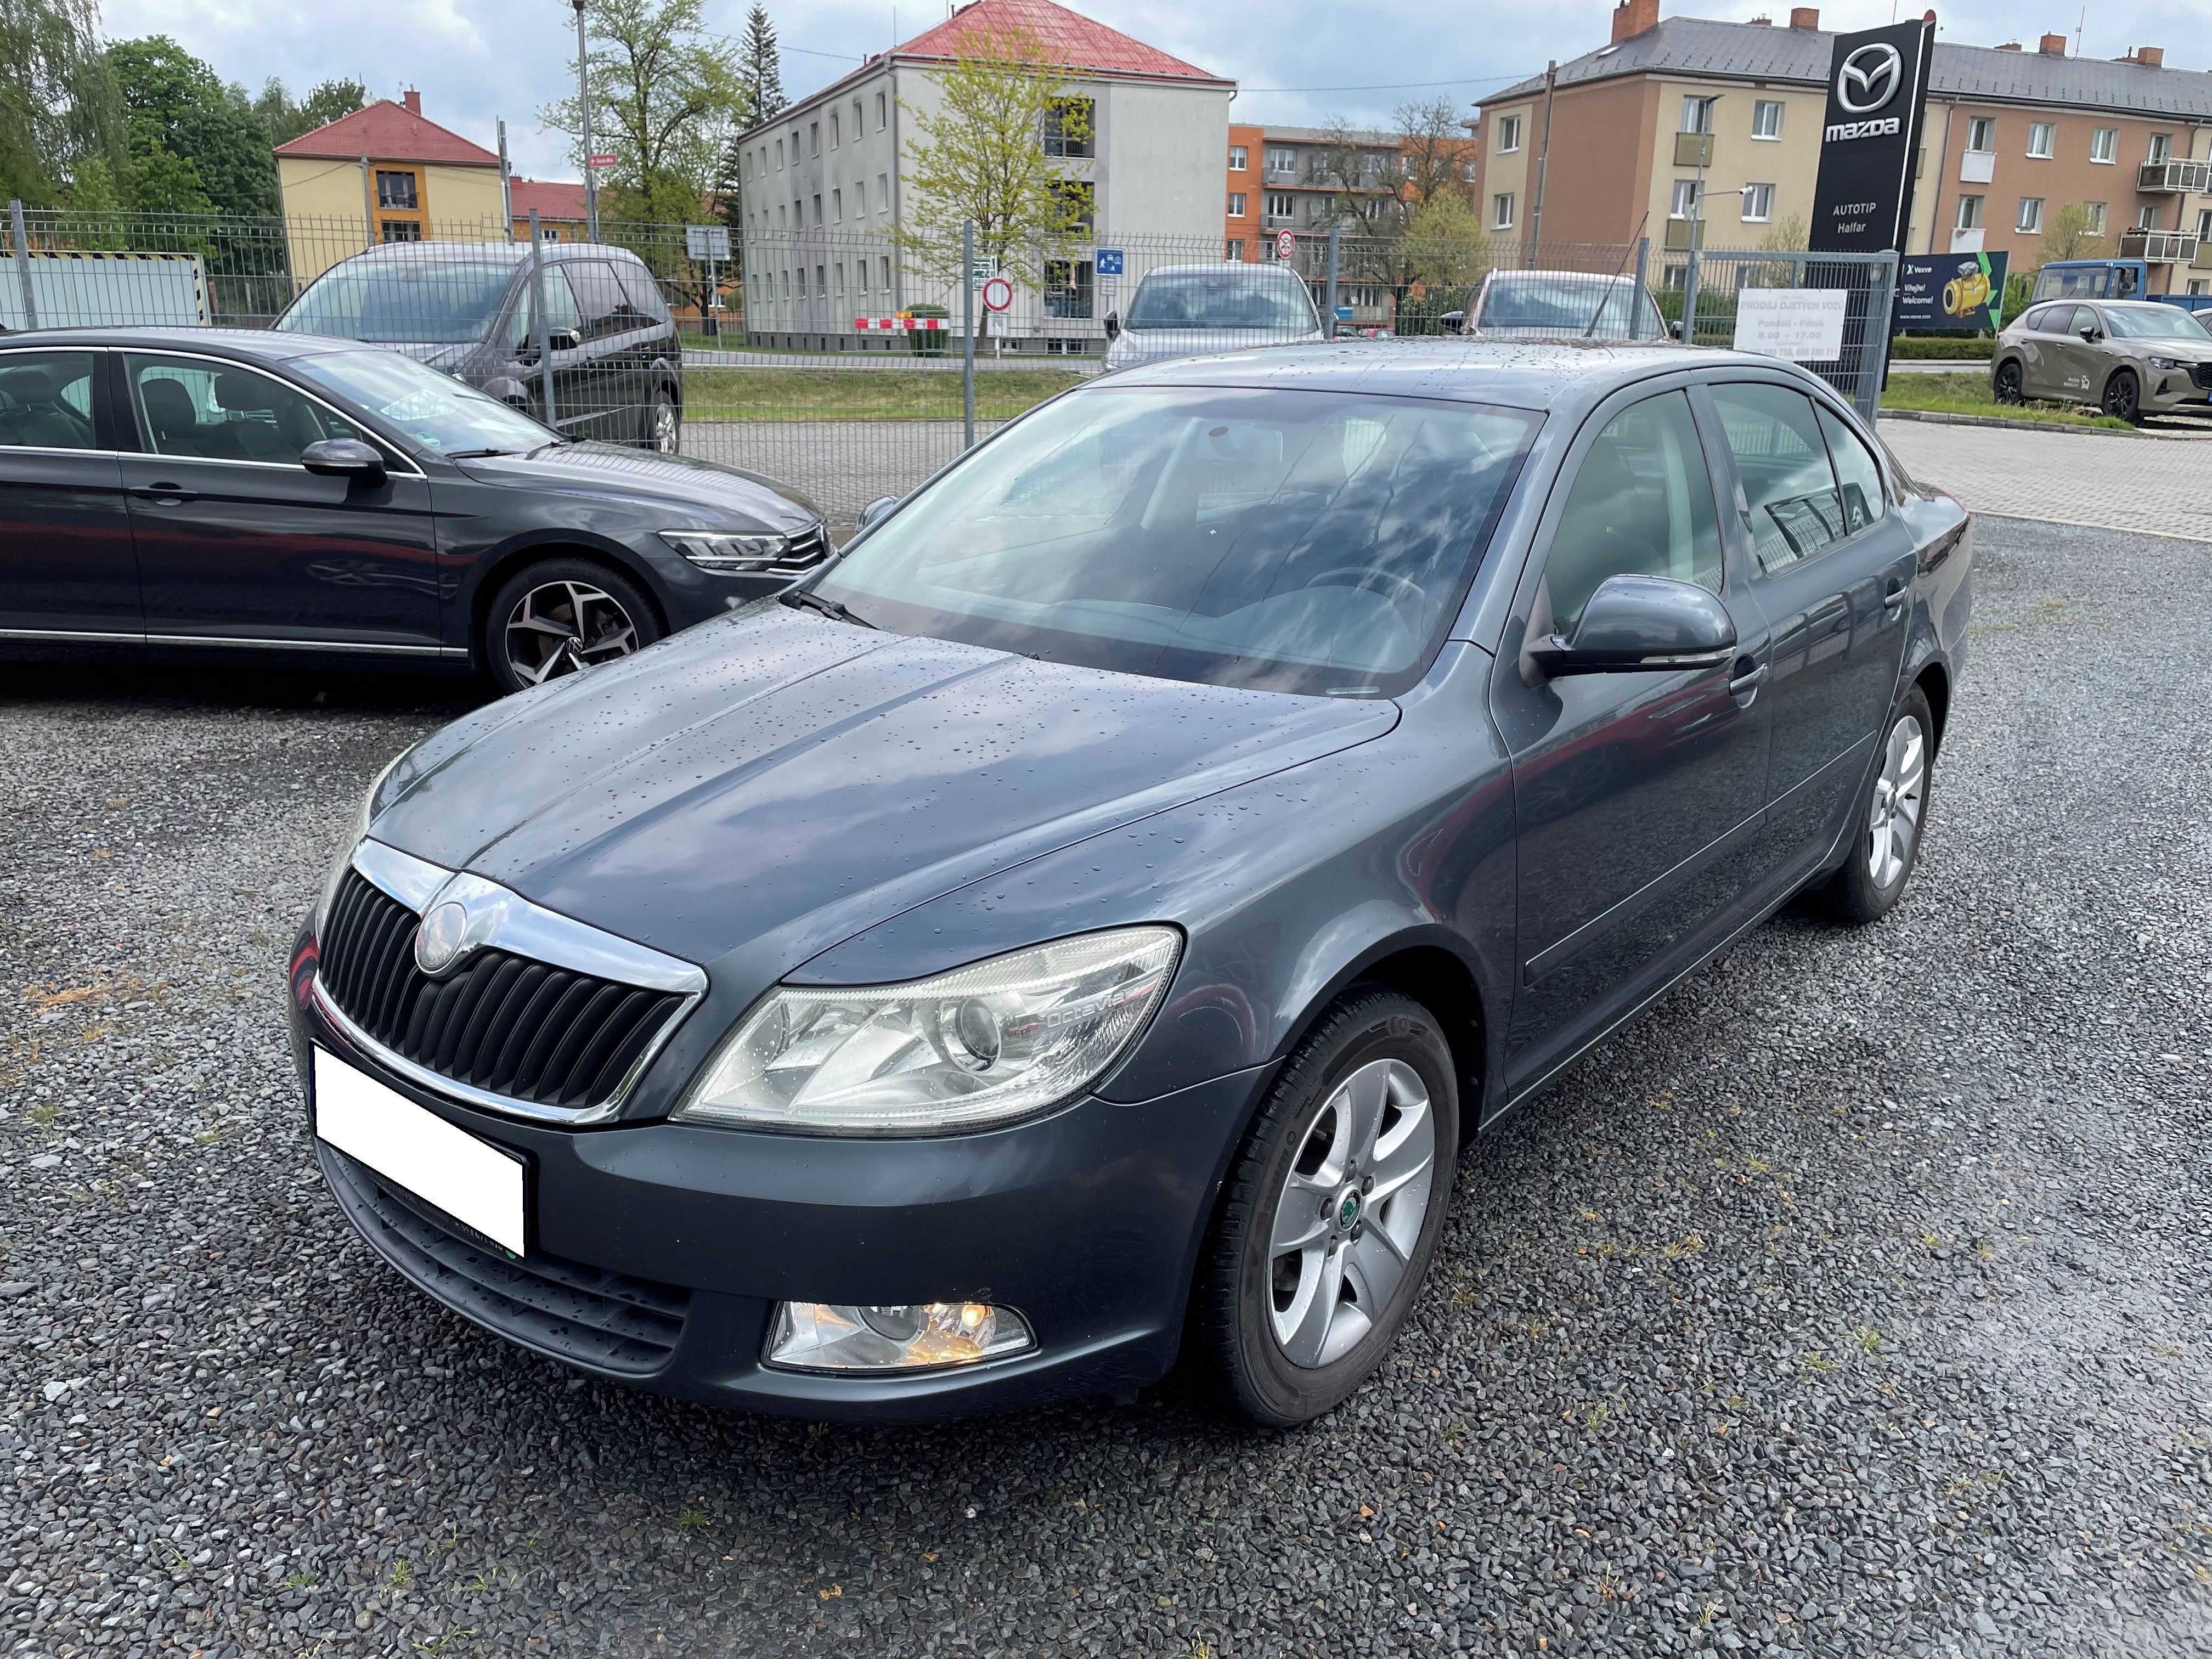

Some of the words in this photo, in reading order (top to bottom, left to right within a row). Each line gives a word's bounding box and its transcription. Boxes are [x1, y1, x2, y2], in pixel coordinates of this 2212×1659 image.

[1832, 202, 1876, 216] AUTOTIP
[1837, 222, 1866, 234] Halfar
[1740, 301, 1778, 310] PRODEJ
[1902, 296, 1933, 304] Welcome!
[1047, 990, 1125, 1028] Octavia
